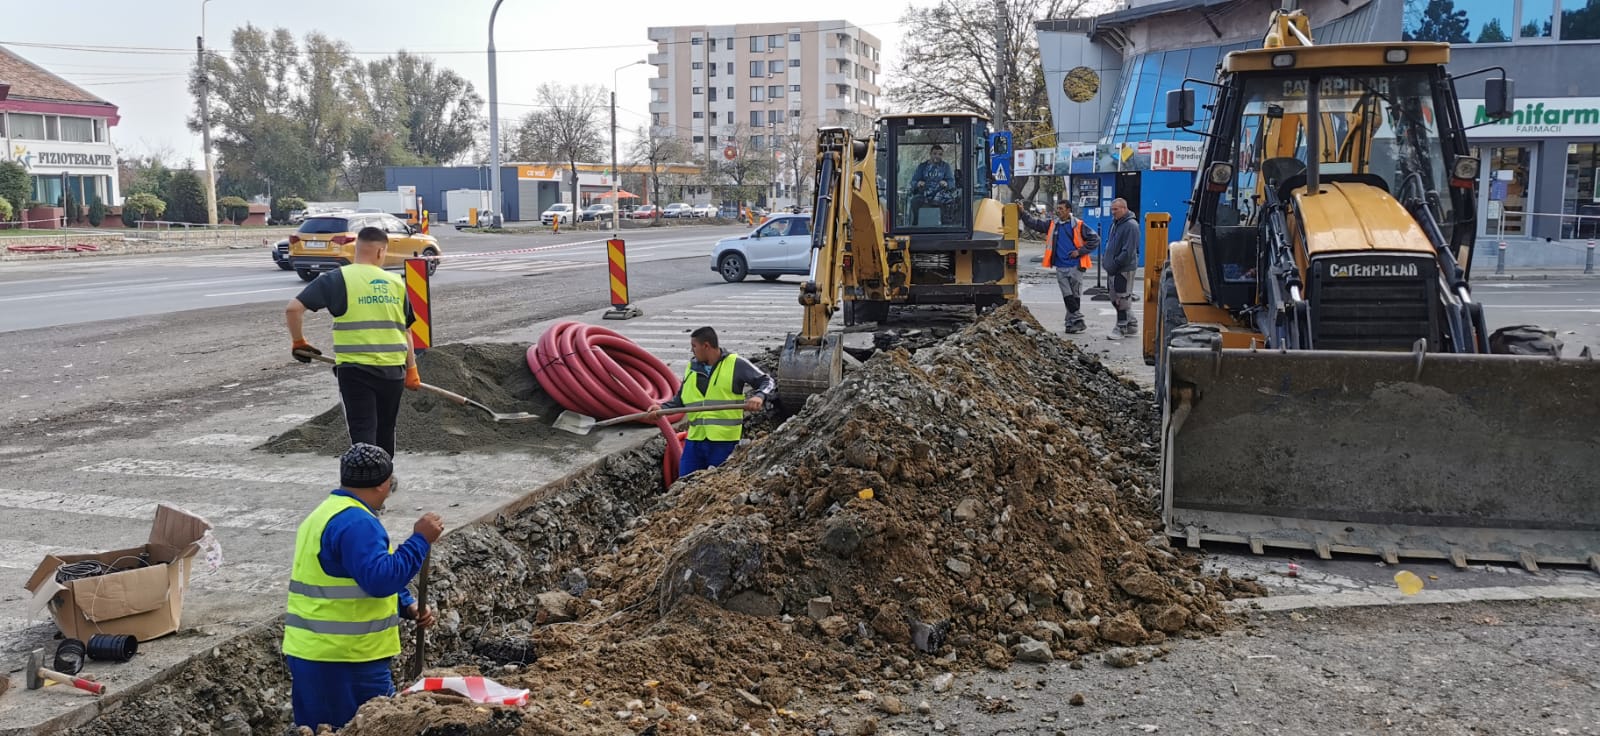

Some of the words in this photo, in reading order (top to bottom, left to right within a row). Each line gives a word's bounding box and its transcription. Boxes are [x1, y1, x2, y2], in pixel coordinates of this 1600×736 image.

[1283, 77, 1389, 97] CATRPILLAR
[1474, 103, 1599, 125] Mnifarm
[1516, 125, 1562, 133] FARMACII
[38, 151, 112, 166] FIZIOTERAPIE
[1330, 263, 1418, 278] CATERPILLAR
[373, 284, 388, 294] HS
